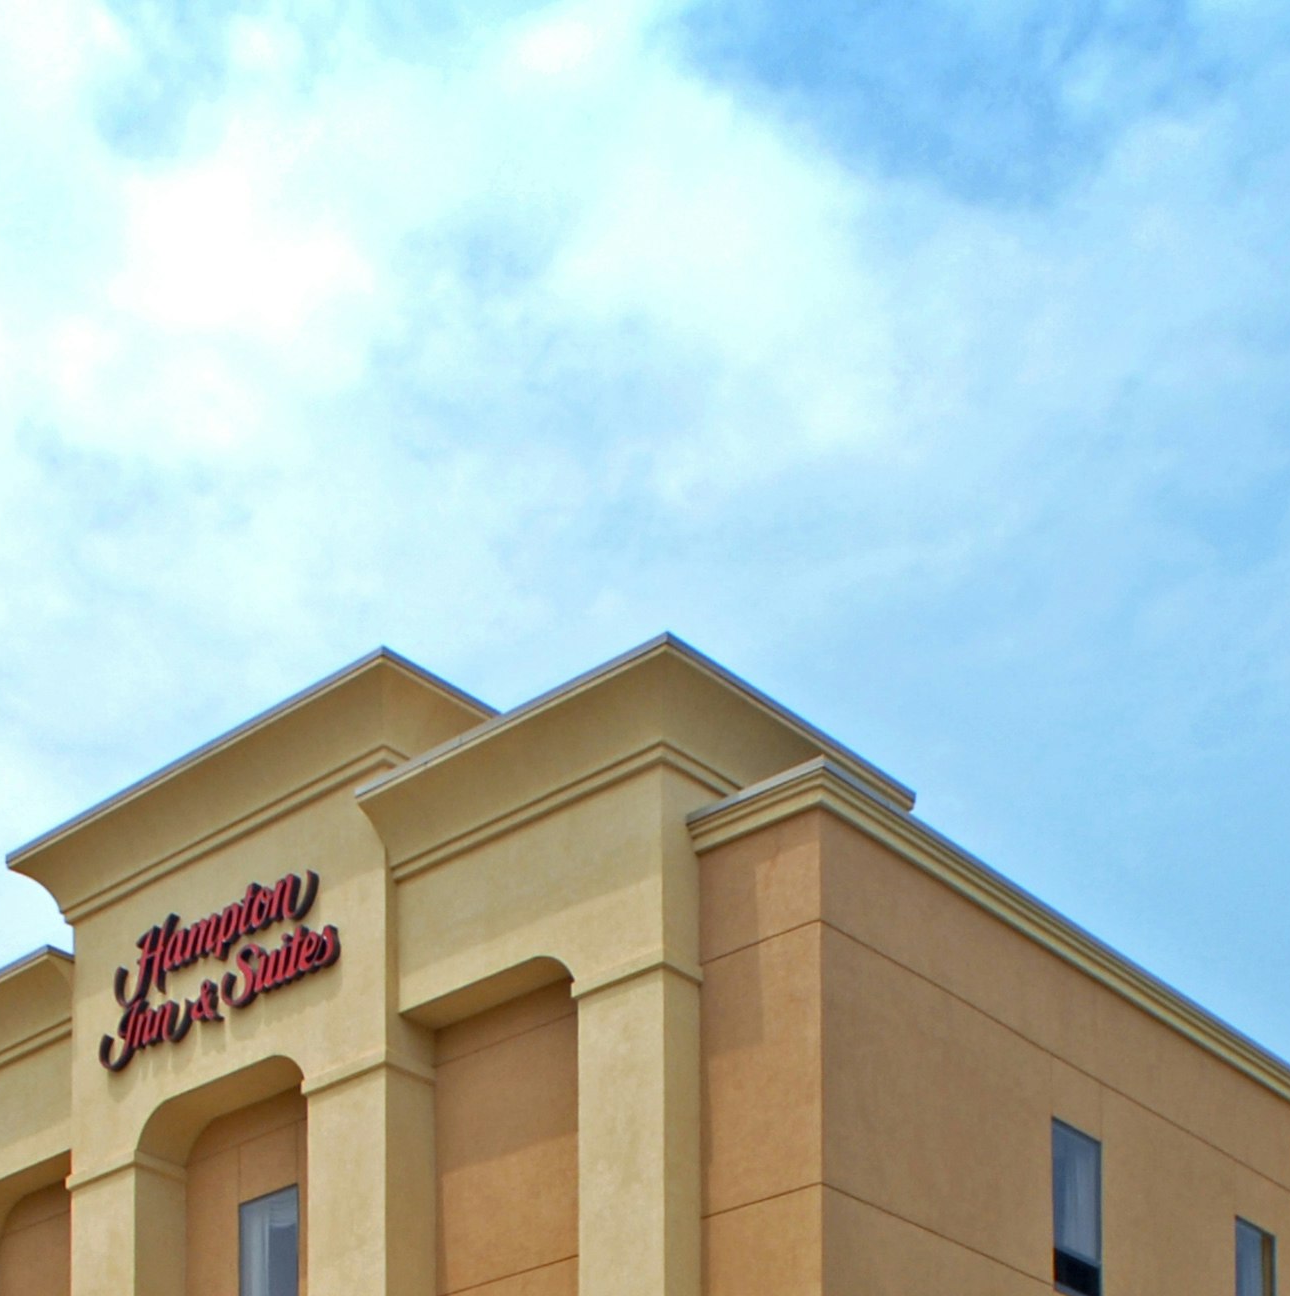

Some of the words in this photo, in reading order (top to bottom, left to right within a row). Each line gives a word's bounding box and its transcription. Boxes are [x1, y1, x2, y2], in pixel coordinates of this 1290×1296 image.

[99, 998, 194, 1072] Inn
[190, 979, 225, 1021] &
[221, 924, 342, 1009] Suites
[114, 869, 320, 1008] Hampton
